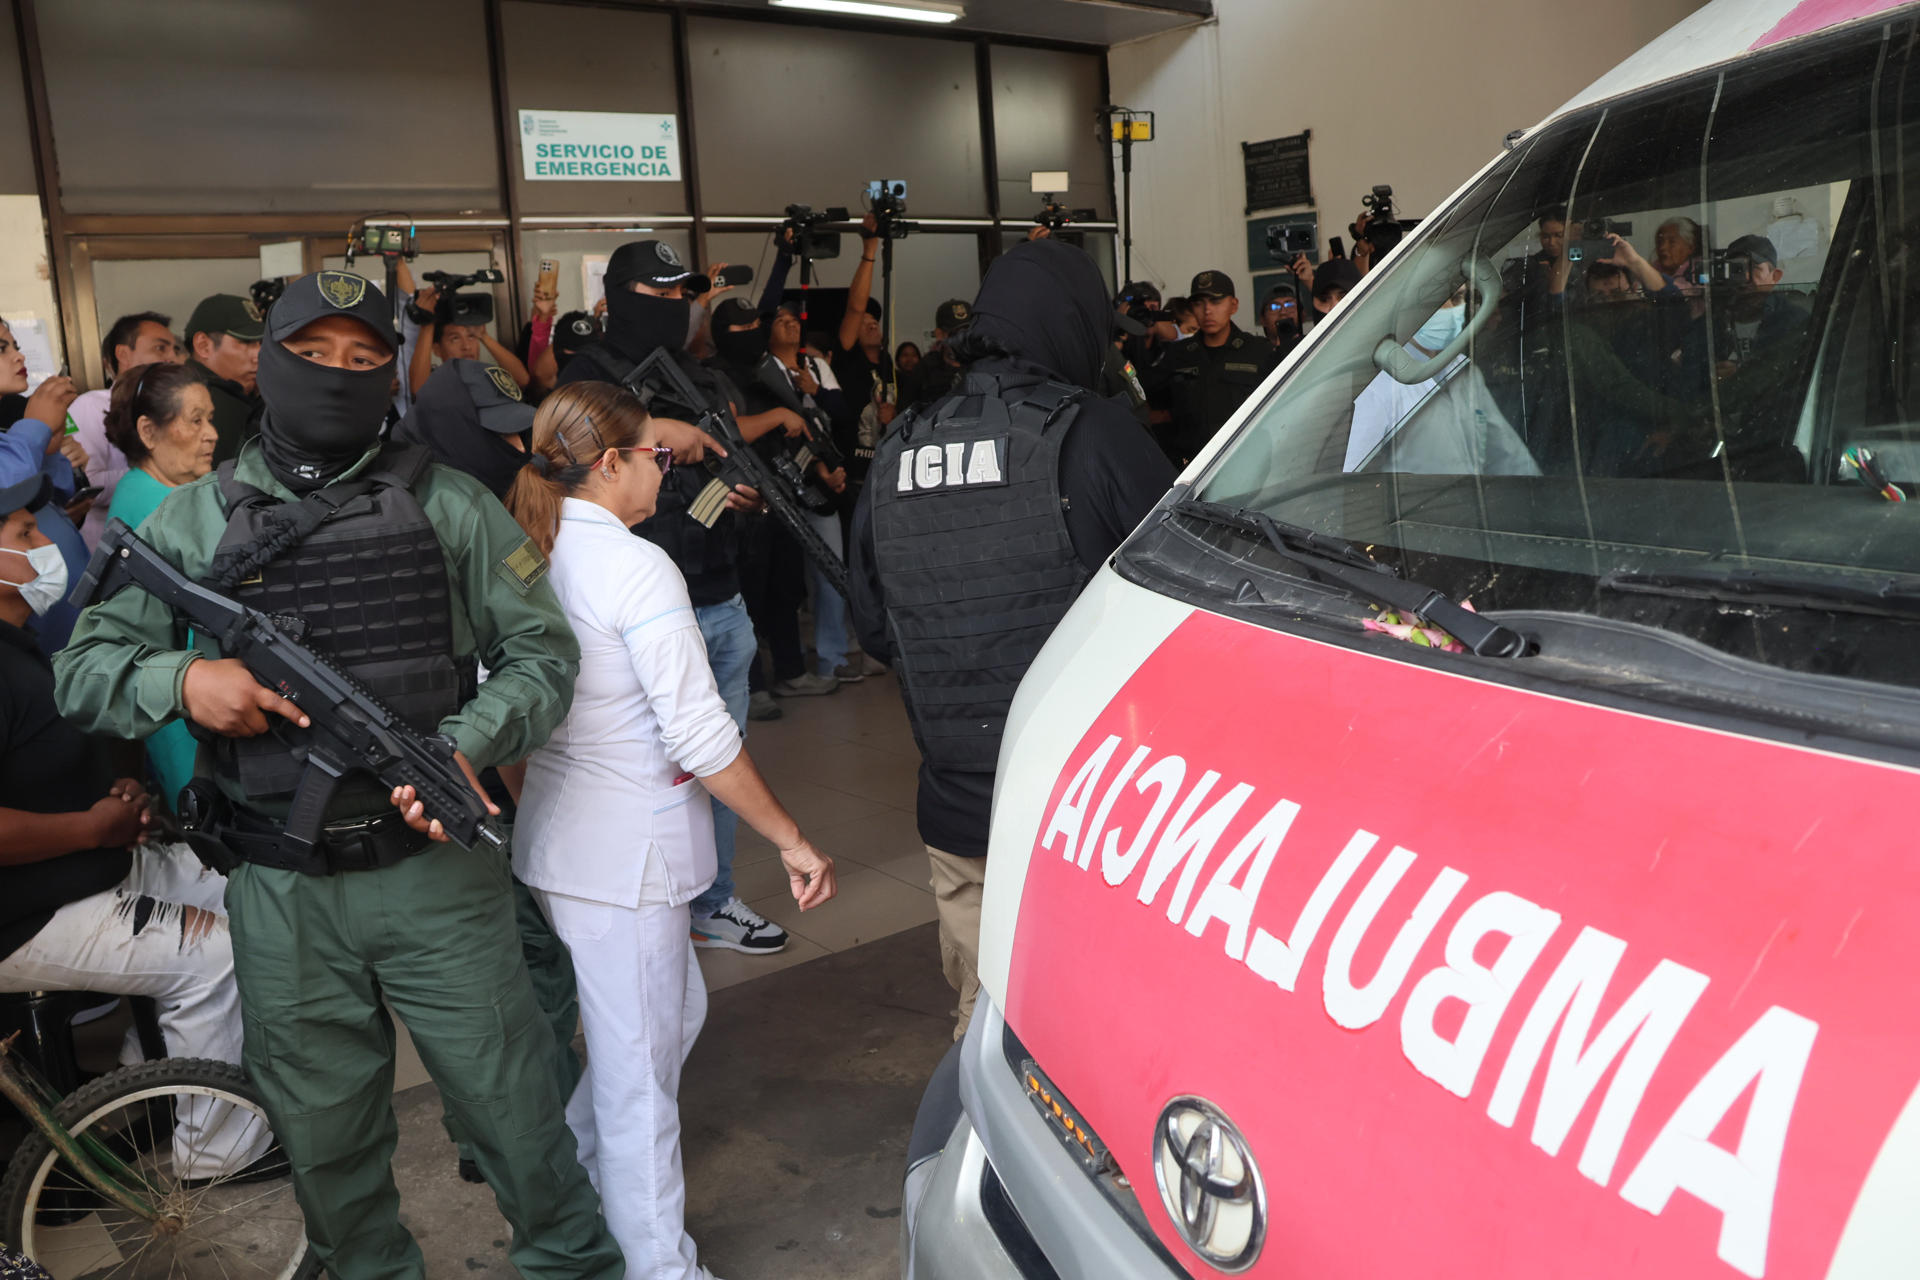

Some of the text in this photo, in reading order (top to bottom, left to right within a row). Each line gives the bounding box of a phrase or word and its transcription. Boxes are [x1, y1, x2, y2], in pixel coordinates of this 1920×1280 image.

[536, 144, 667, 159] SERVICIO DE
[535, 161, 672, 176] EMERGENCIA
